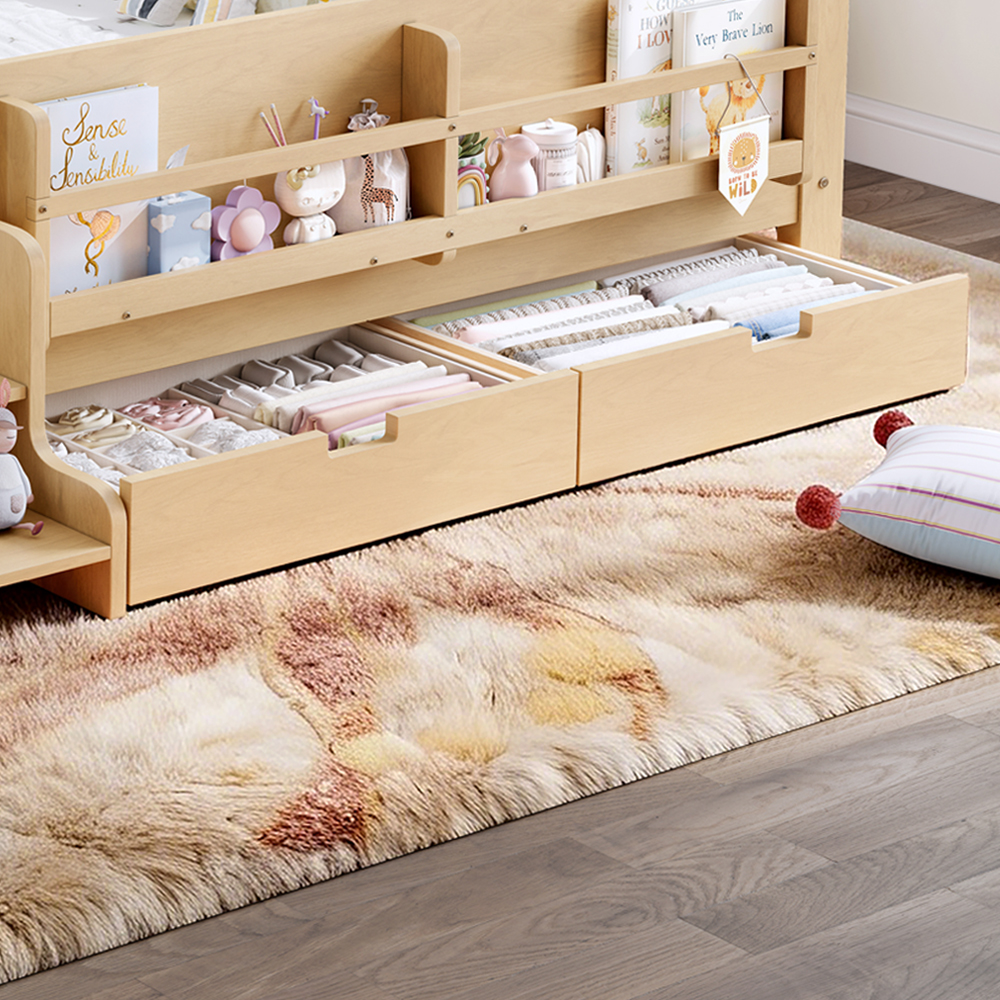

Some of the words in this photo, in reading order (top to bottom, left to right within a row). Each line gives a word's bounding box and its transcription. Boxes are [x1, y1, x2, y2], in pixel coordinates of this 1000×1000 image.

[640, 13, 670, 31] HOW
[727, 9, 743, 22] The
[638, 34, 642, 49] I
[646, 30, 671, 48] LOV
[696, 33, 718, 49] Very
[722, 28, 748, 42] Brave
[752, 22, 773, 36] Lion
[62, 102, 127, 146] Sense
[88, 143, 99, 161] &
